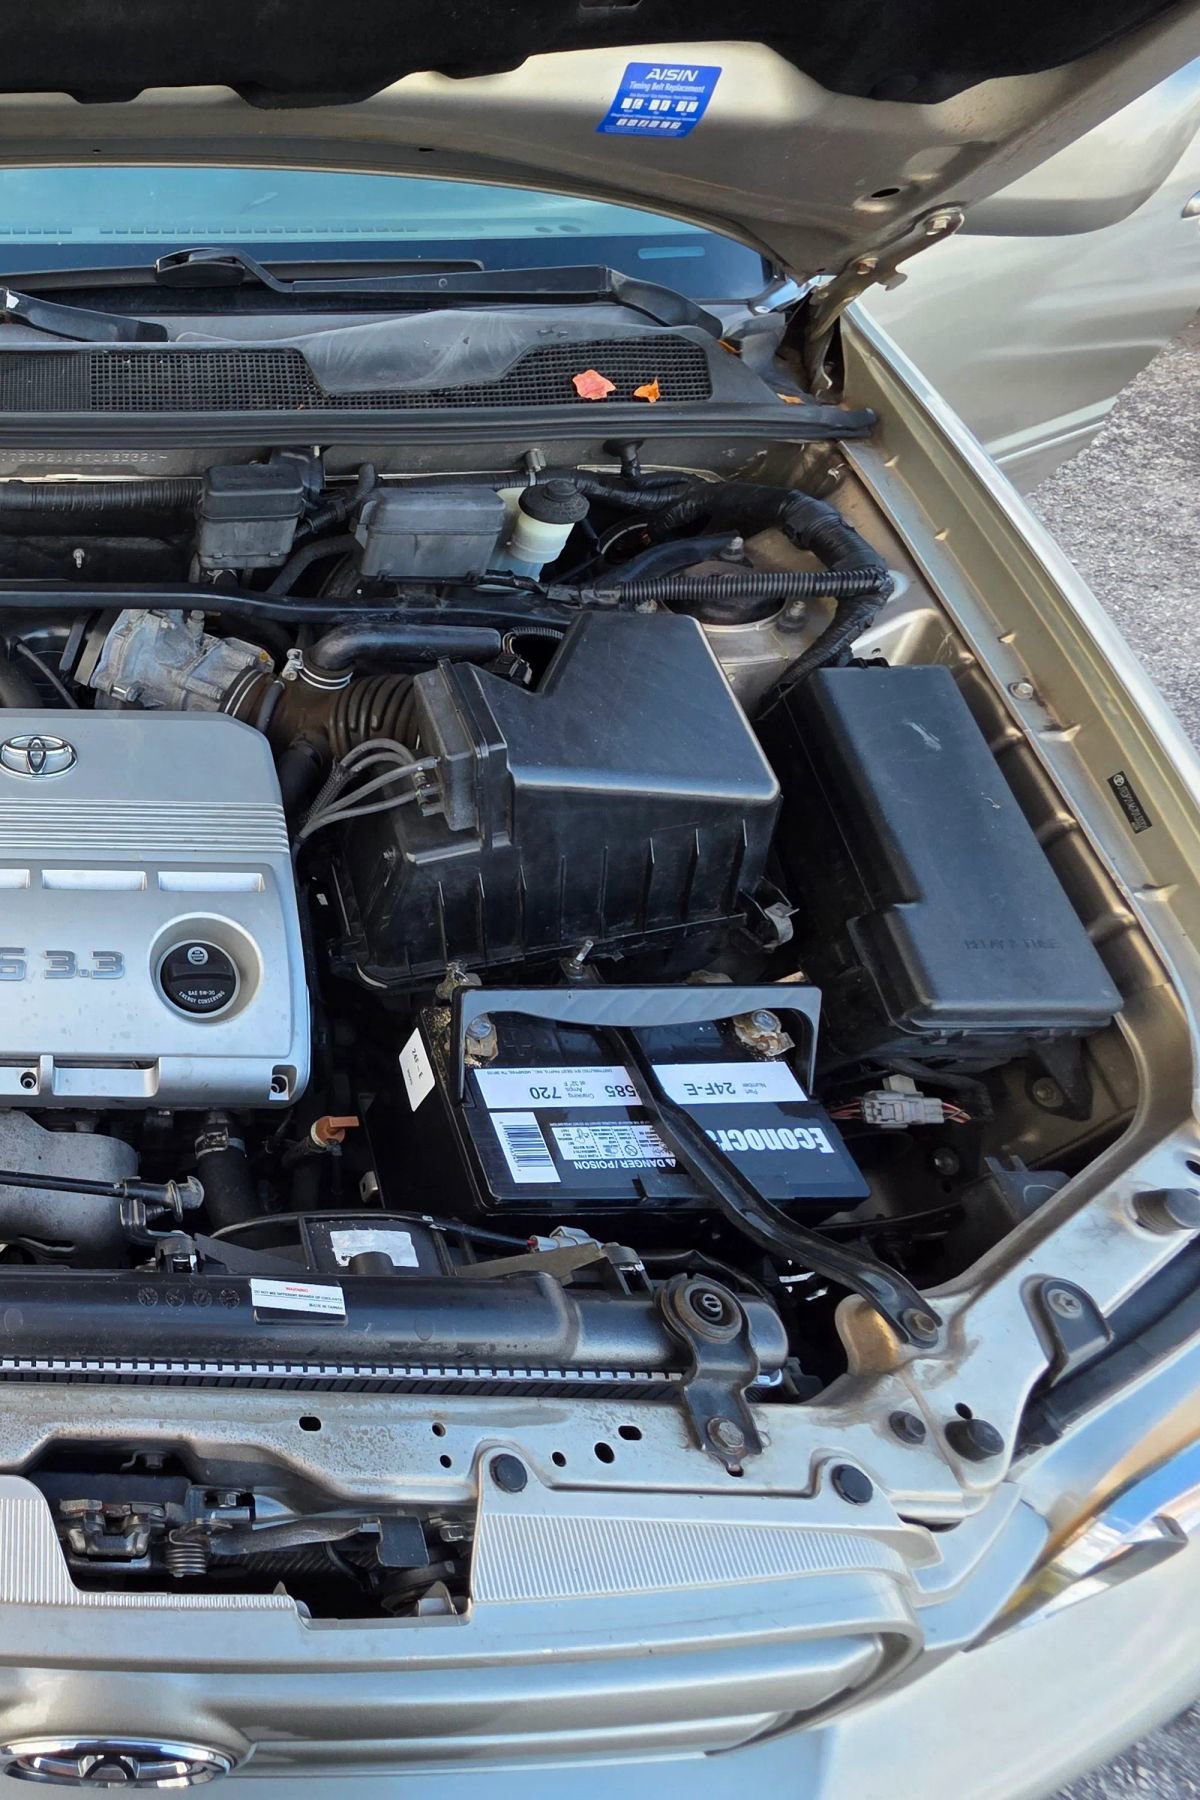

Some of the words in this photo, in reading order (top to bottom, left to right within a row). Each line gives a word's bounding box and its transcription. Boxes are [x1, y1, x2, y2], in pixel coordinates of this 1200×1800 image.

[646, 67, 698, 82] AISIN
[629, 81, 650, 92] Timing
[651, 82, 664, 91] Belt
[665, 83, 705, 94] Replacement
[43, 949, 126, 980] 3.3
[178, 991, 197, 1003] ENERGY
[198, 990, 226, 1004] CONSERVING
[529, 1086, 562, 1099] 720
[604, 1084, 636, 1098] 585
[683, 1082, 736, 1096] 24F-E
[620, 1158, 667, 1168] DANGER
